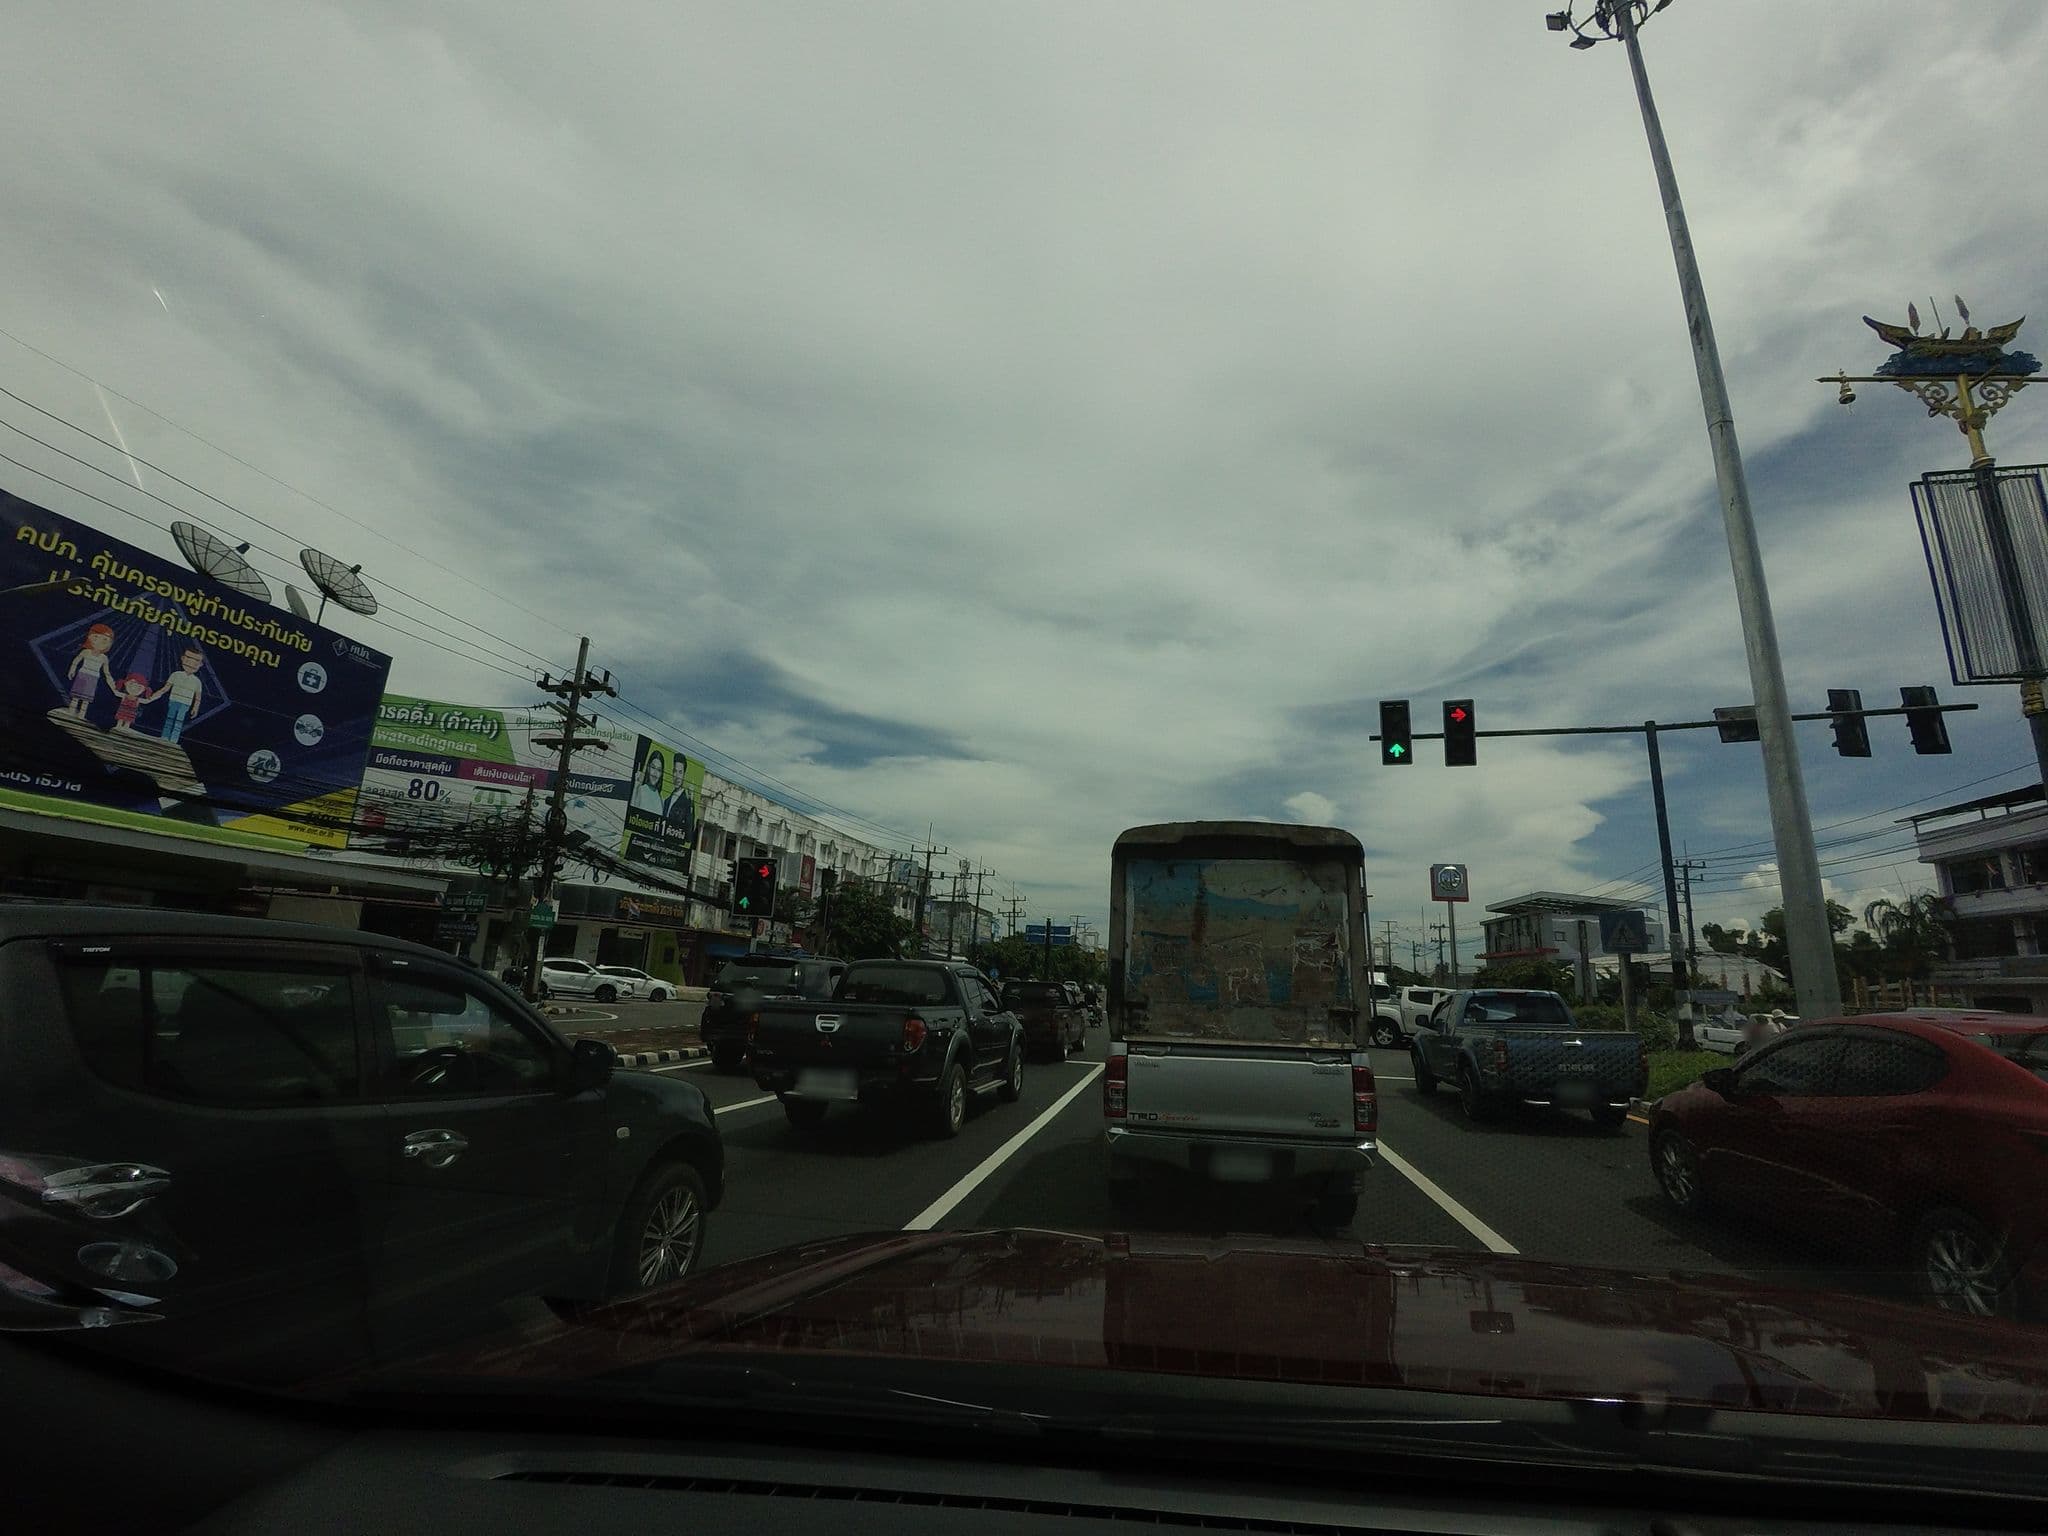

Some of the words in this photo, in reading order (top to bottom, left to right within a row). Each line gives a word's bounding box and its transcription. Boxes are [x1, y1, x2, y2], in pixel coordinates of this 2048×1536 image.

[16, 524, 83, 564] คปภ.
[91, 550, 312, 653] คุ้มครองผู้ทำประกันภัย
[440, 711, 499, 739] (ค้าส่ง)
[408, 778, 452, 804] 80%
[1129, 1112, 1158, 1121] TRD
